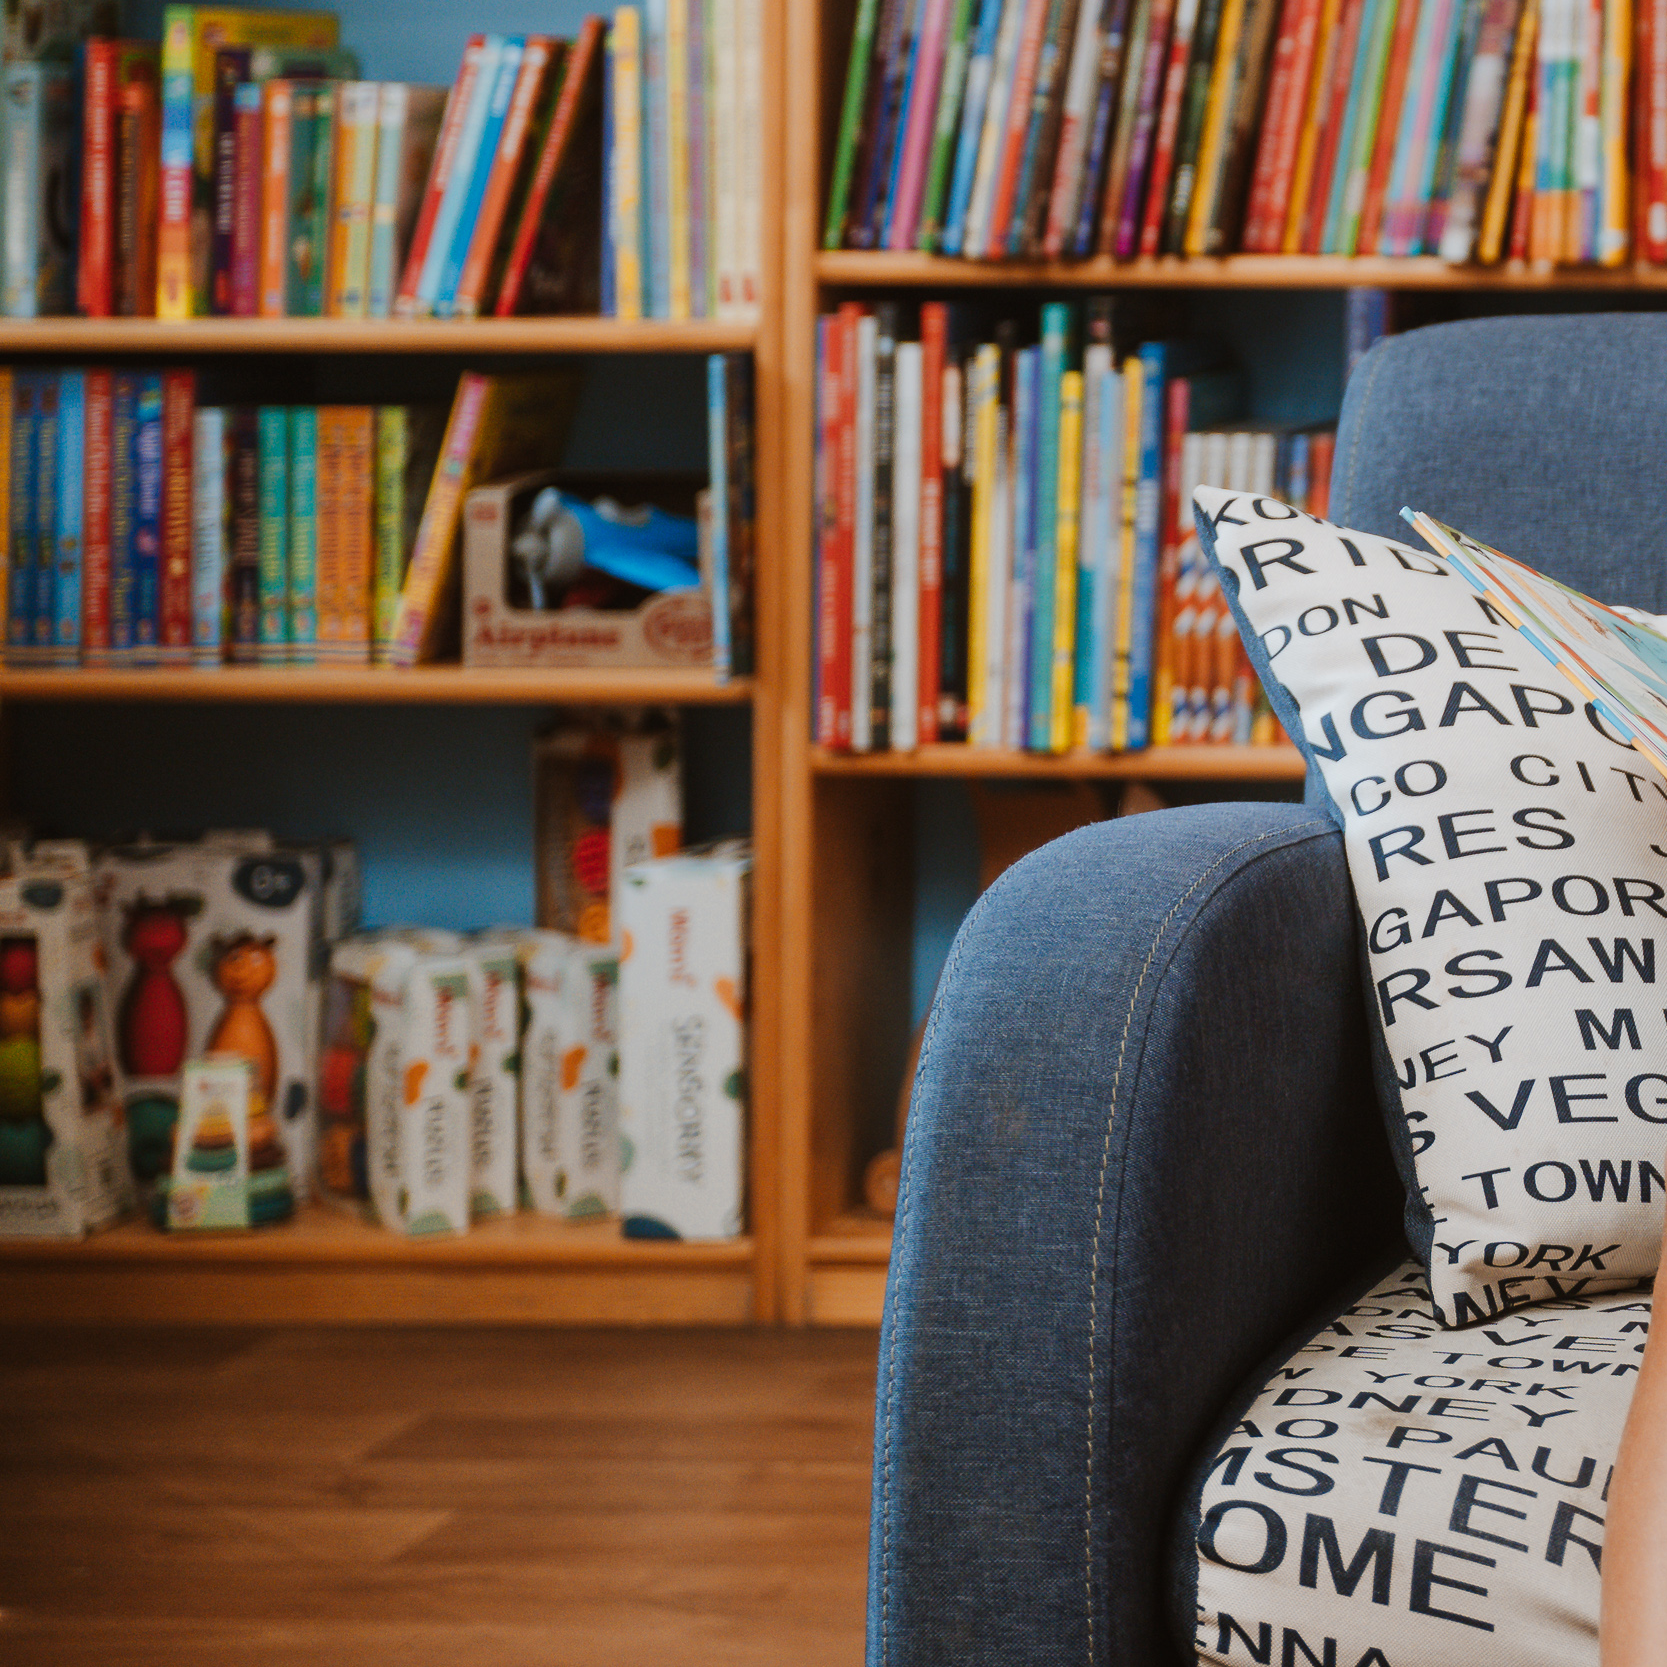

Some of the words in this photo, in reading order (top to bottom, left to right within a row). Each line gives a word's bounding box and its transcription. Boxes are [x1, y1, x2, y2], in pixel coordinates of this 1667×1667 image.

[1222, 537, 1451, 601] RID
[1361, 628, 1518, 679] DE
[1368, 806, 1577, 883] RES
[1377, 936, 1658, 1027] RSAW
[1434, 1239, 1622, 1273] YORK
[1261, 1387, 1581, 1429] DNEY
[1363, 1369, 1581, 1401] YORK
[1385, 1424, 1615, 1502] PAU
[1196, 1499, 1497, 1633] OME
